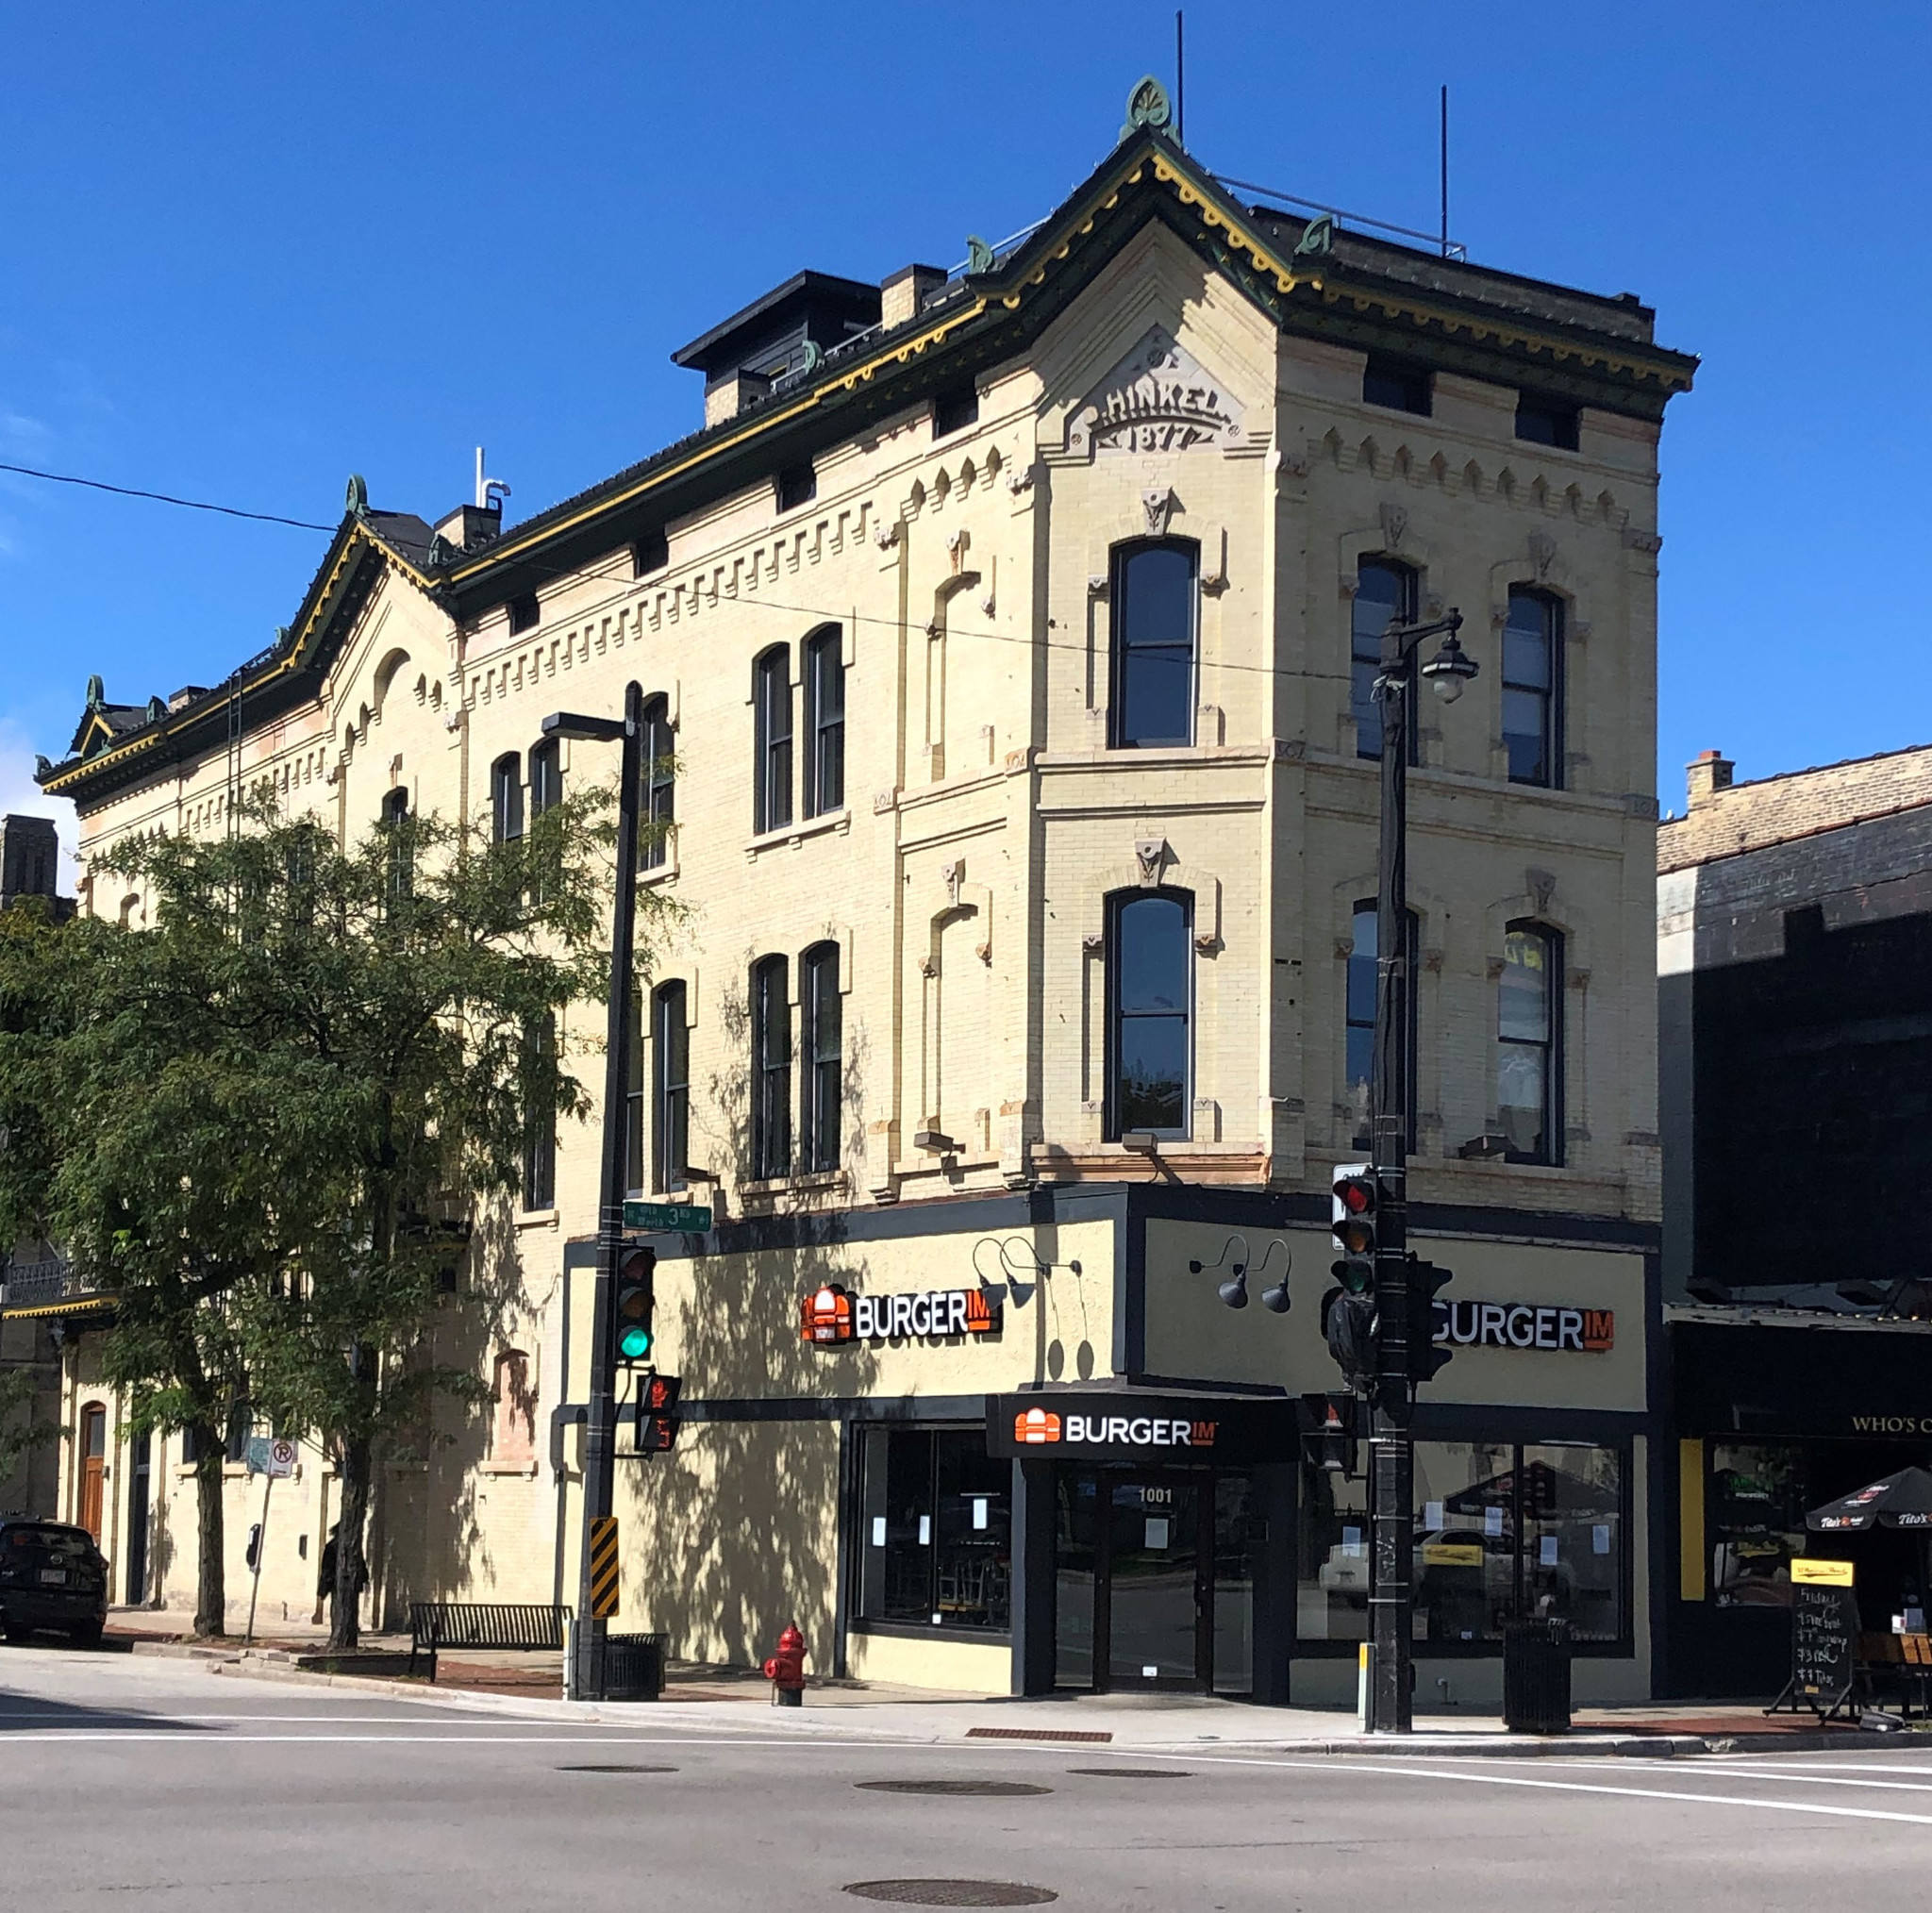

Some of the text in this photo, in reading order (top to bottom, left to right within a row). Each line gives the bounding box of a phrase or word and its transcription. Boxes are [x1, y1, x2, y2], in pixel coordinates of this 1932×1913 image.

[1106, 382, 1218, 416] HINKEL
[1124, 424, 1193, 453] 1877
[1066, 1416, 1215, 1445] BURGERIM
[1852, 1417, 1916, 1434] WHO'S
[1138, 1487, 1172, 1504] 1001
[1898, 1512, 1928, 1525] Tito's
